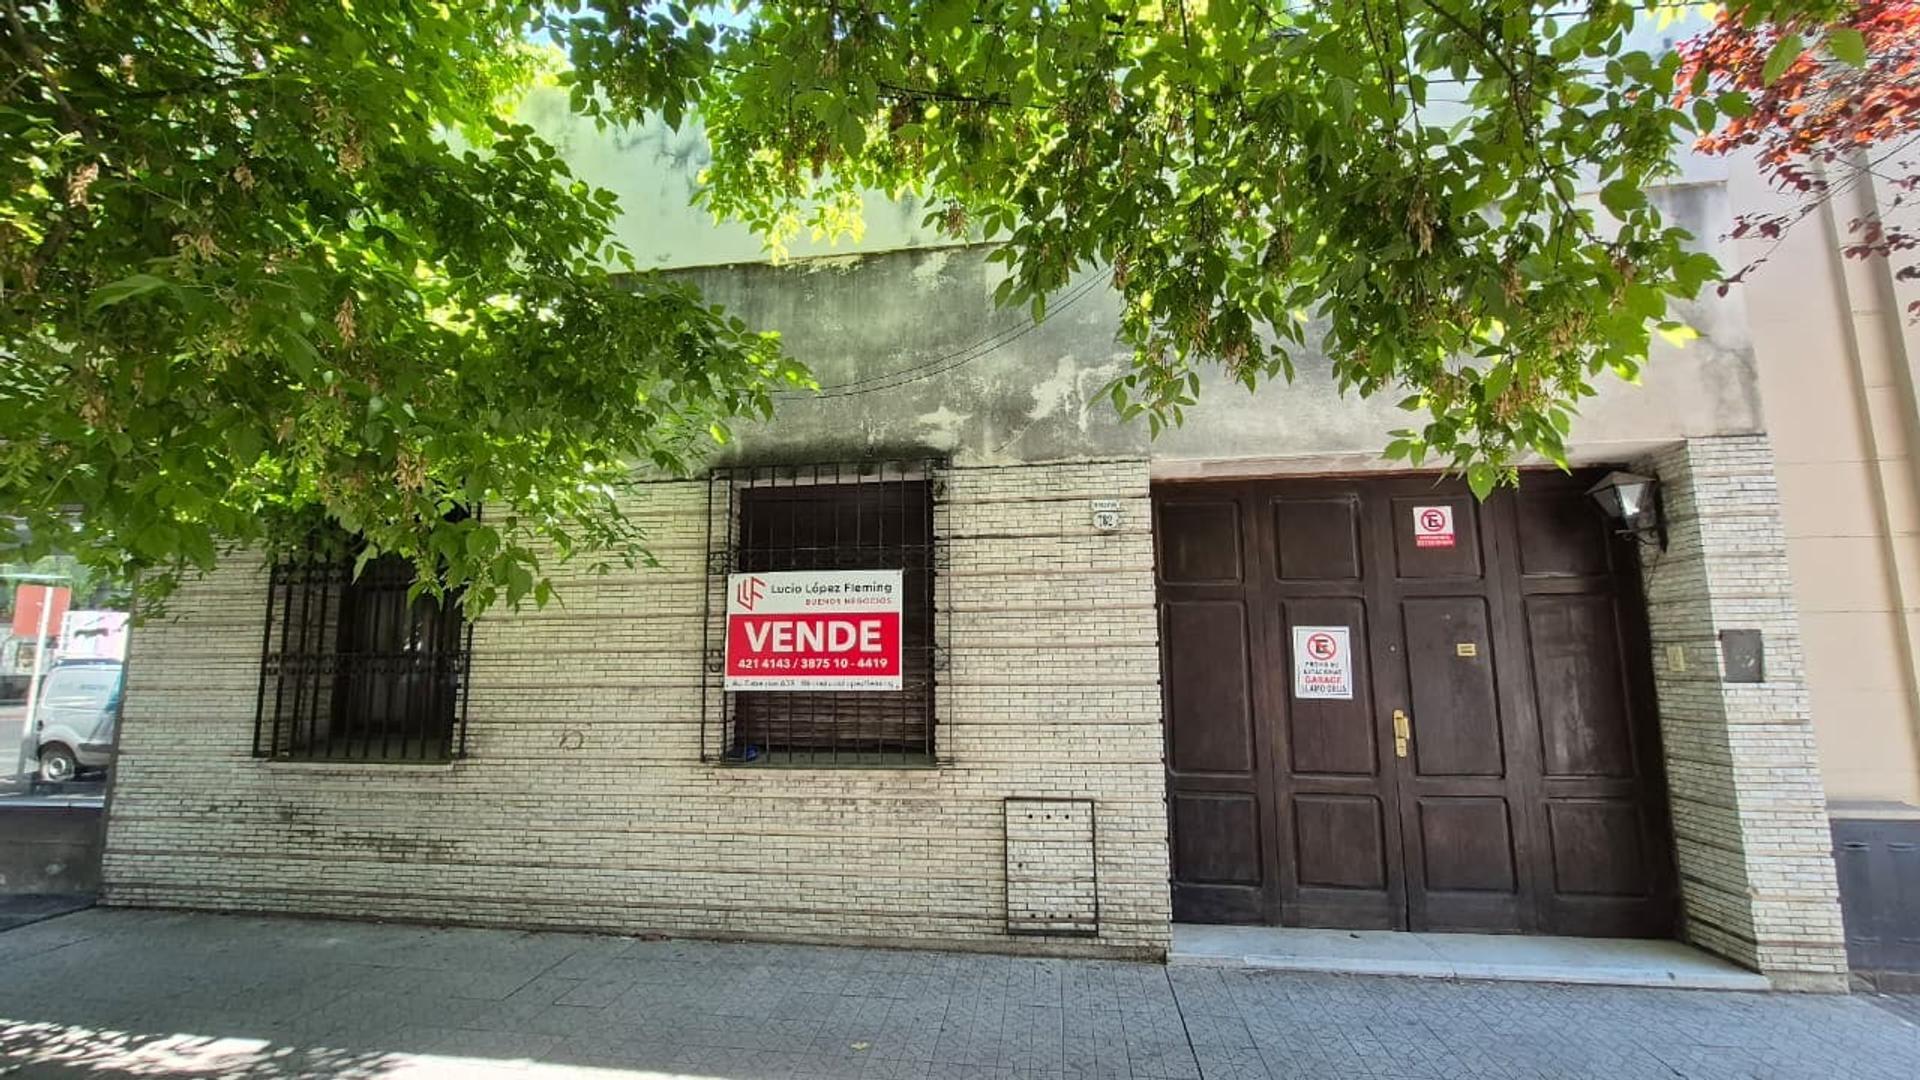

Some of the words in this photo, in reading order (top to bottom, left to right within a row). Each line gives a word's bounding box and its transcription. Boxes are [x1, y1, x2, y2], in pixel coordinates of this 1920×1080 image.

[771, 583, 802, 595] Lucio
[805, 581, 840, 597] López
[844, 580, 892, 595] Fleming
[805, 598, 841, 607] BUENOS
[844, 597, 892, 606] NEGOCIOS
[744, 620, 882, 653] VENDE
[738, 658, 759, 670] 421
[762, 658, 790, 670] 4143
[801, 658, 830, 670] 3875
[833, 658, 848, 669] 10
[857, 658, 888, 669] 4419
[1305, 675, 1341, 684] GARAGE
